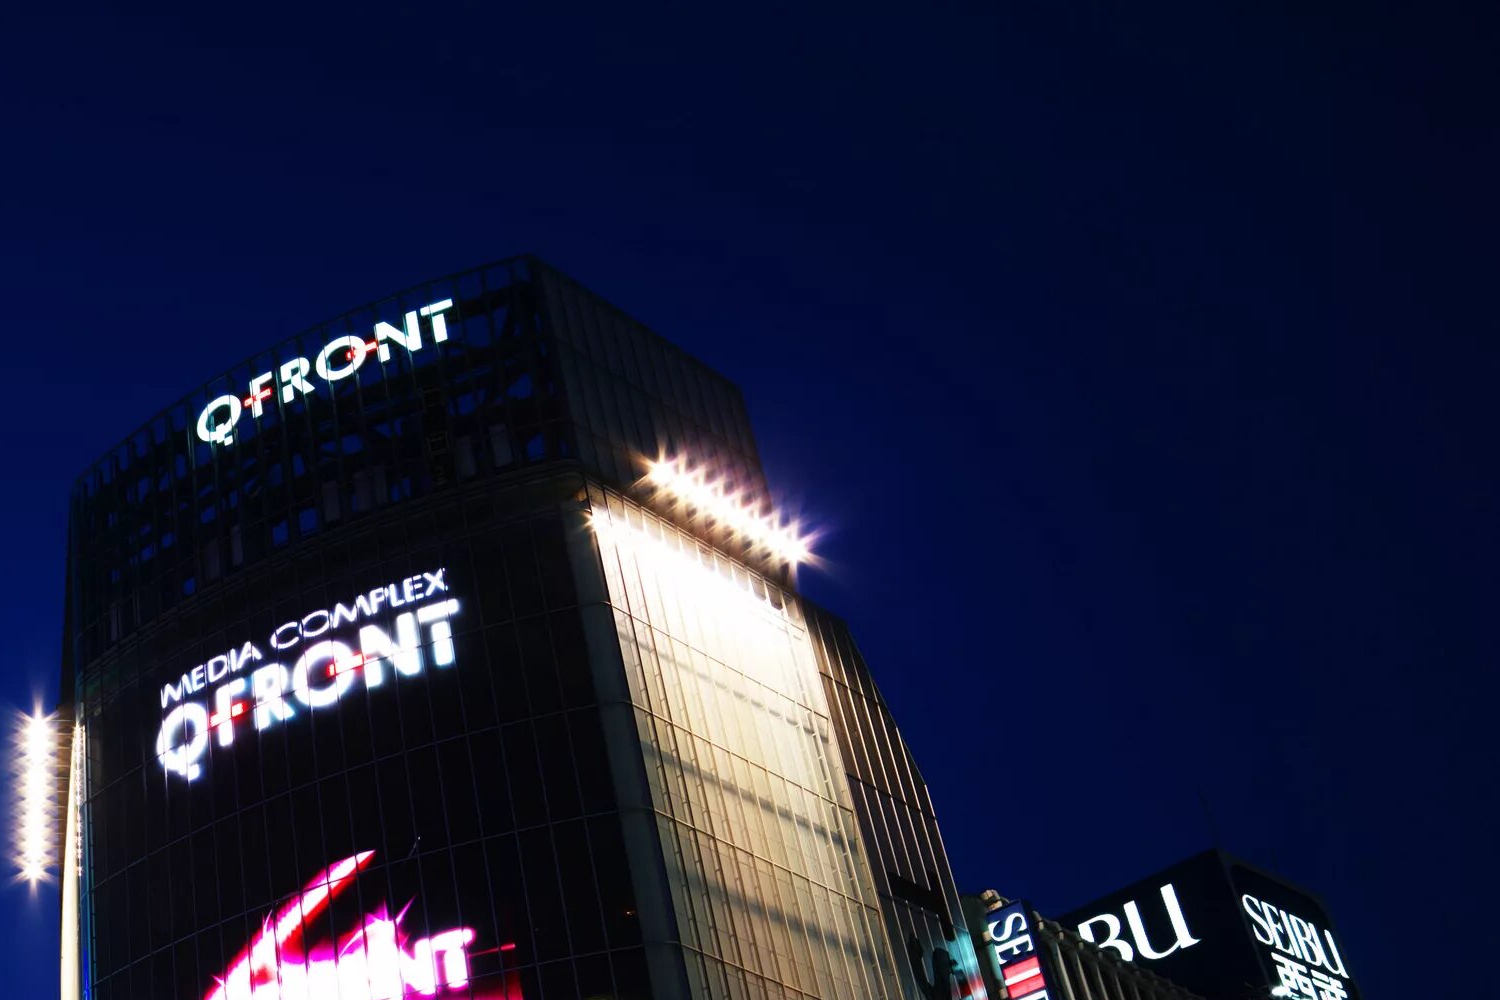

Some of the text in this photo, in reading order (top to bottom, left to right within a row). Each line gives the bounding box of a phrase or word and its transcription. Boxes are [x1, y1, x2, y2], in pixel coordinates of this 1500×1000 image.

[196, 298, 453, 446] QFRONT
[156, 598, 461, 782] QFRONT
[161, 567, 449, 708] MEDIA COMPLEX
[1241, 893, 1351, 979] SEIBU
